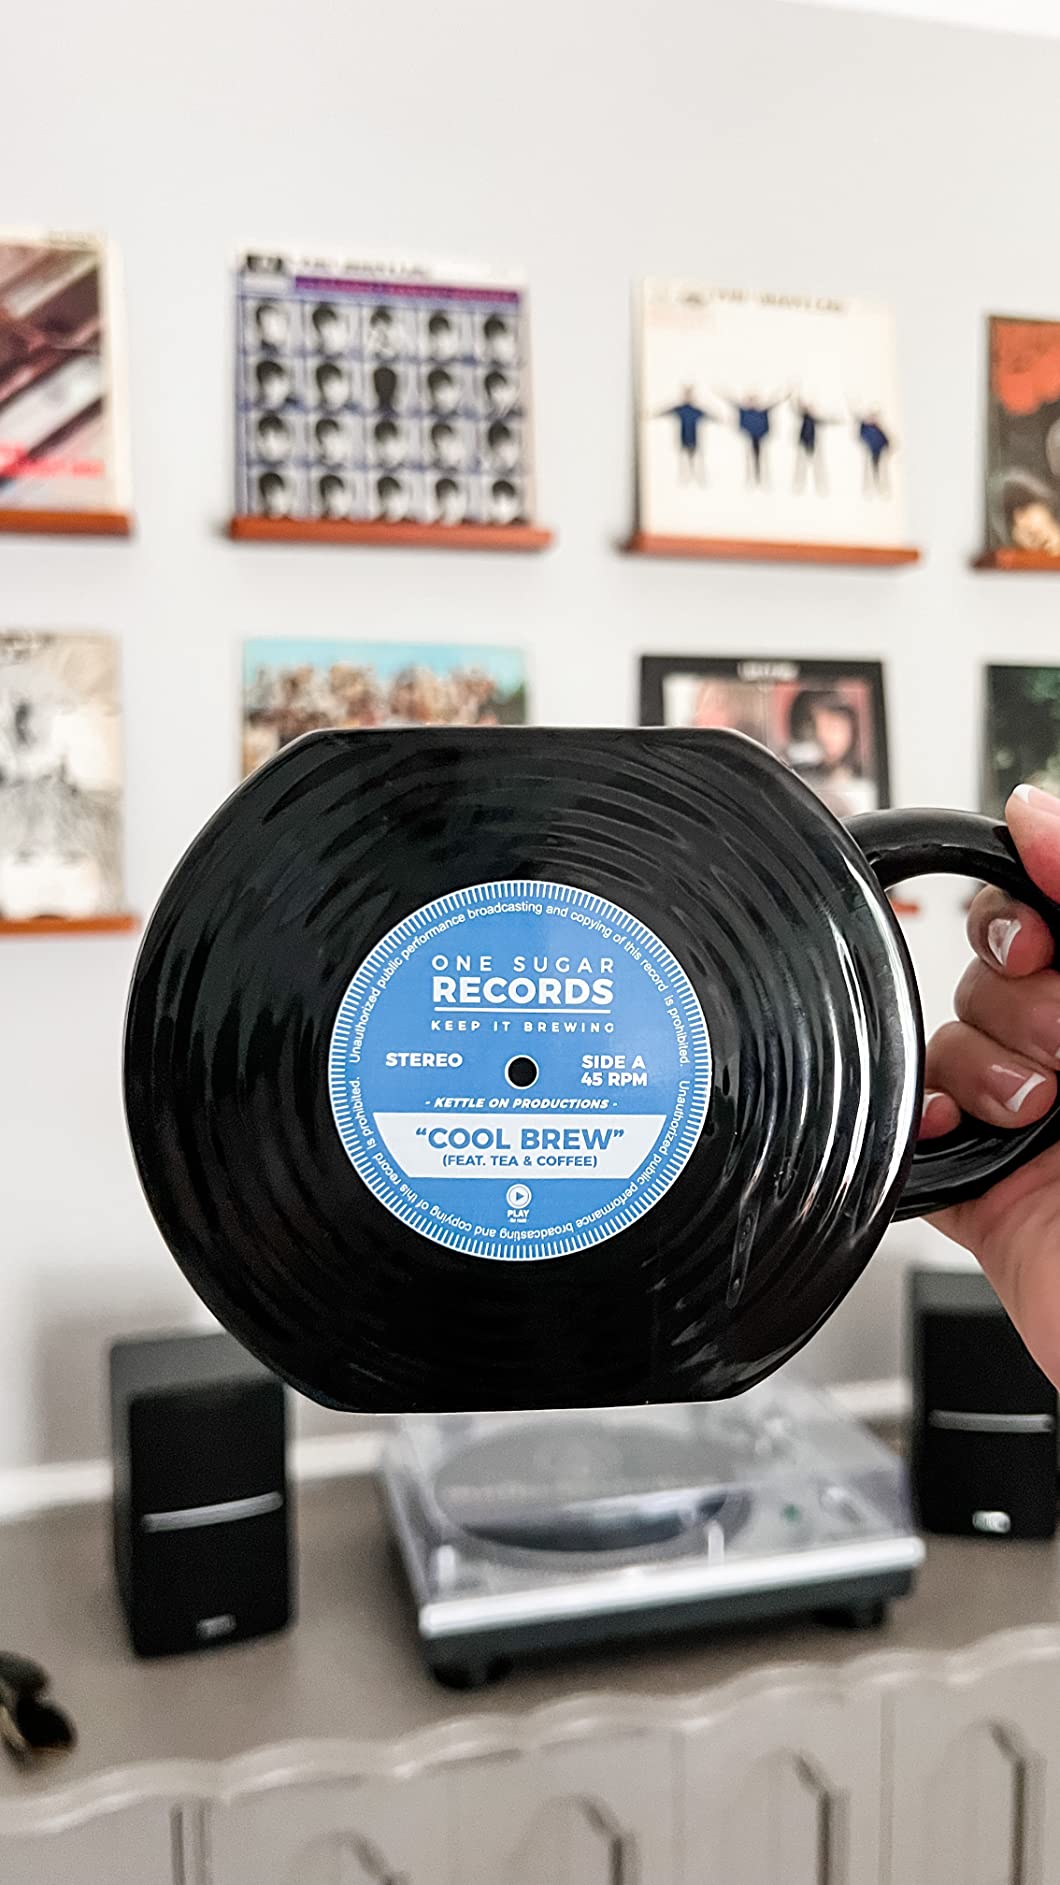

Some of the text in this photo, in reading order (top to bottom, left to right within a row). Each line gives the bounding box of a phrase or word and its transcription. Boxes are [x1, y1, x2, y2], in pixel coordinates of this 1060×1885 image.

[431, 955, 614, 974] ONE SUGAR
[349, 901, 690, 1067] Unauthorized public performance broadcasting and copying of this record is prohibited.
[432, 976, 614, 1005] RECORDS
[431, 1020, 614, 1034] KEEP IT BREWING
[385, 1052, 463, 1067] STEREO
[581, 1055, 646, 1069] SIDE A
[581, 1073, 648, 1087] 45 RPM
[434, 1097, 486, 1108] KETTLE
[488, 1098, 508, 1108] ON
[512, 1098, 610, 1109] PRODUCTIONS
[415, 1127, 625, 1150] “COOL BREW”
[349, 1076, 690, 1242] Unauthorized public performance broadcasting and copying of this record is prohibited.
[442, 1154, 598, 1168] (FEAT. TEA & COFFEE)
[507, 1209, 530, 1218] PLAY
